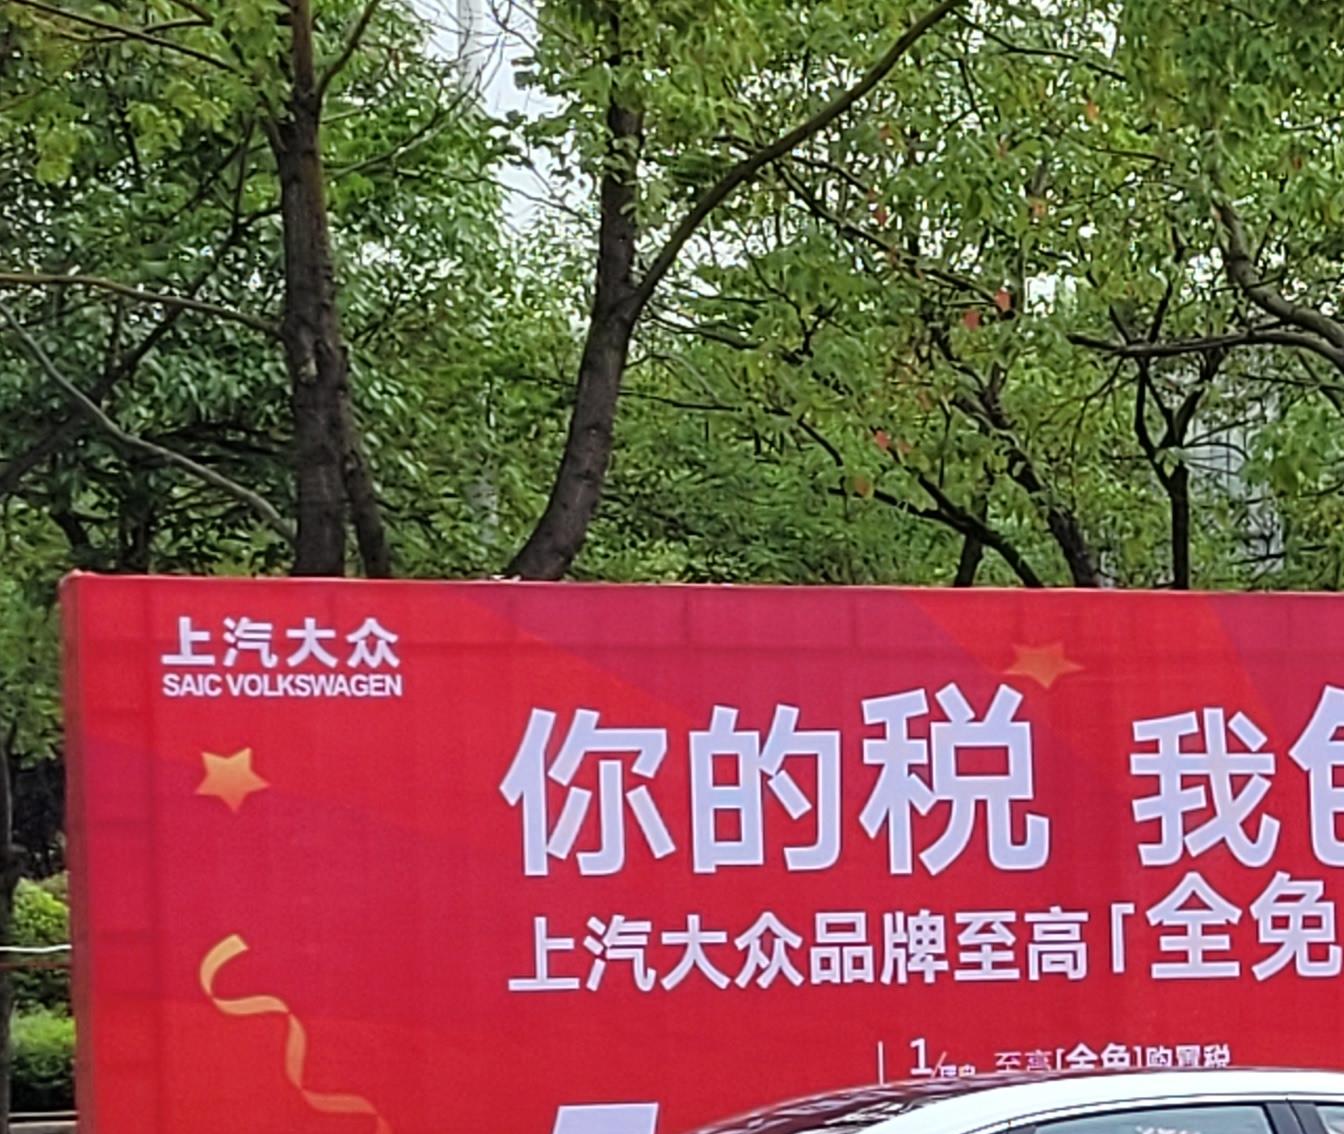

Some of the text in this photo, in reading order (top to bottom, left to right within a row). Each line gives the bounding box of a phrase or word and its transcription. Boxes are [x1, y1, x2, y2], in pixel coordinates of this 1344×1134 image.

[161, 616, 400, 668] 上汽大众
[163, 673, 403, 697] SAIC VOLKSWAGEN
[499, 682, 1051, 876] 你的税
